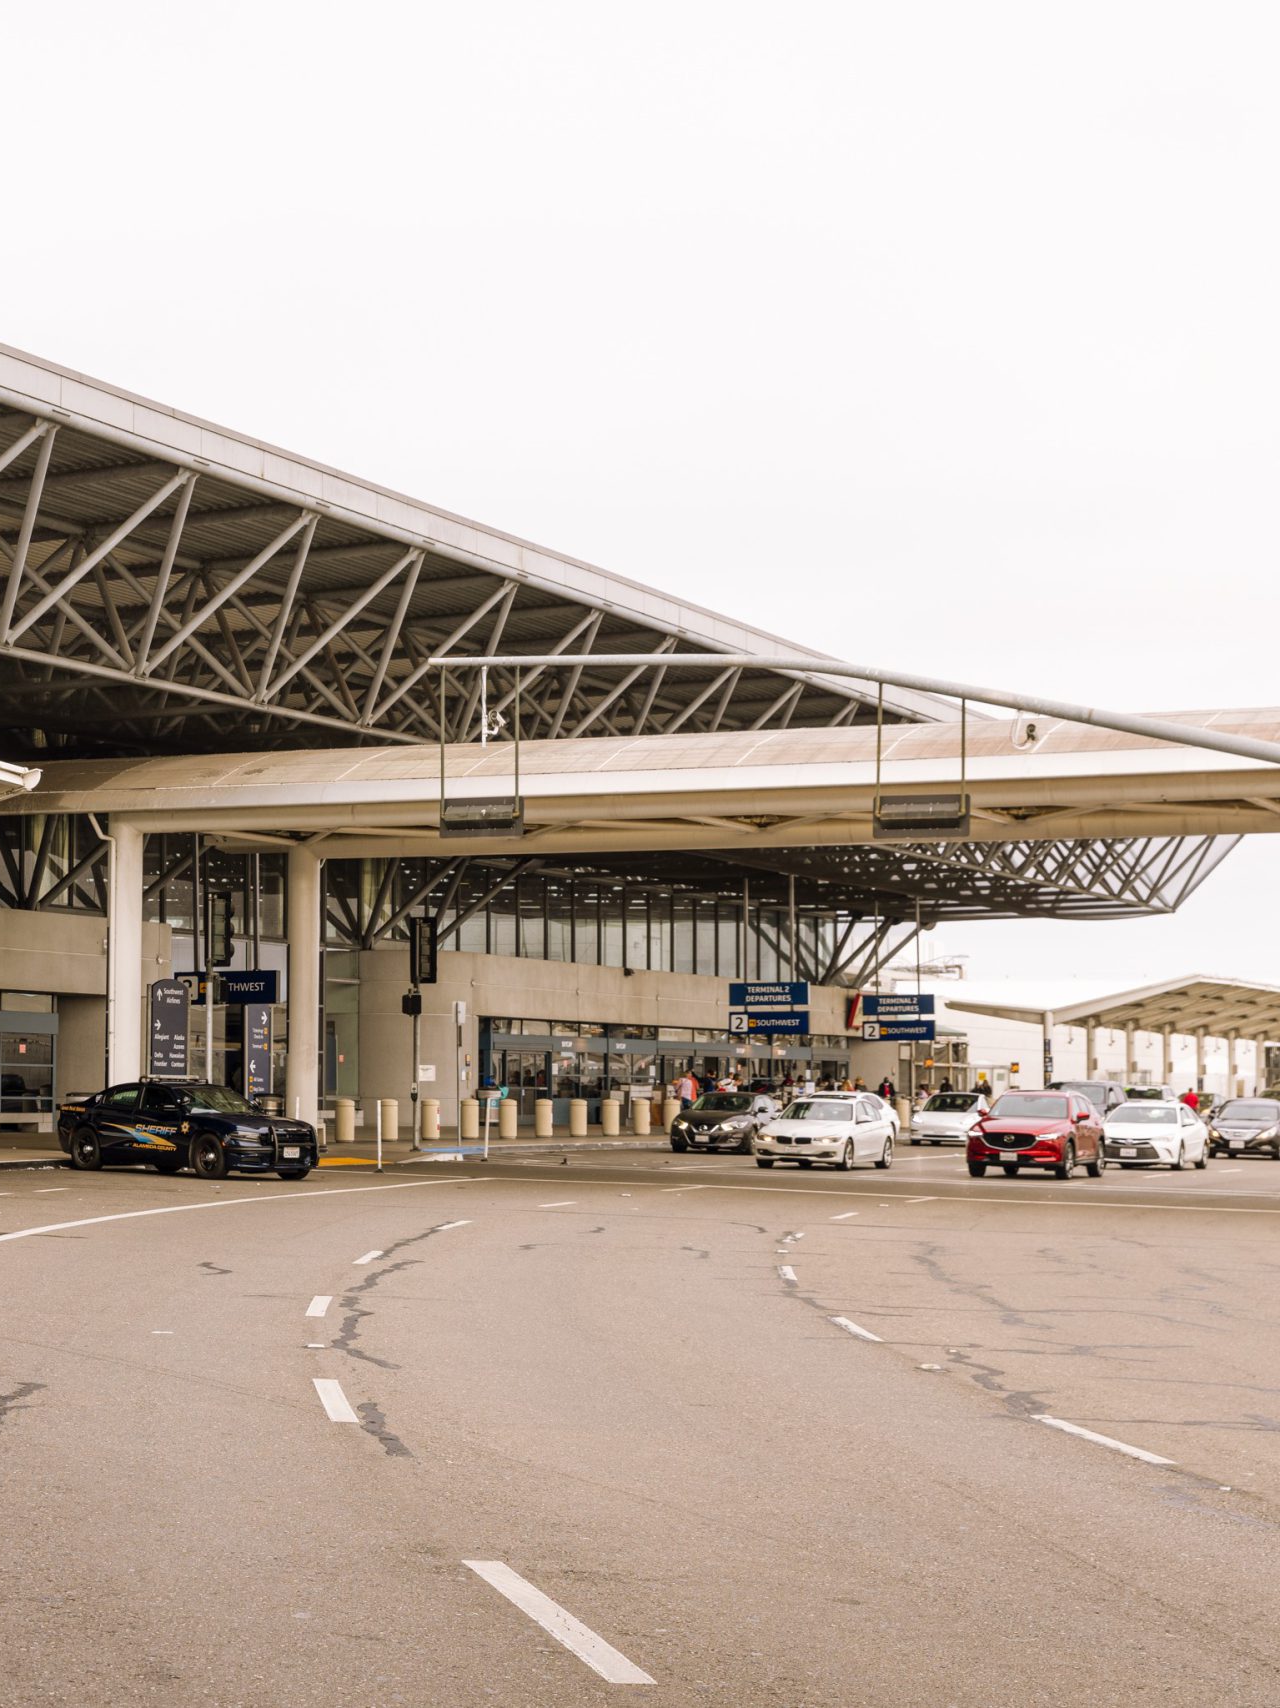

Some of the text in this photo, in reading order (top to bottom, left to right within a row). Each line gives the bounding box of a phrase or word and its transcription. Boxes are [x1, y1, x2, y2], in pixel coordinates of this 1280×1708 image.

[784, 985, 790, 993] 2
[745, 994, 792, 1002] DEPARTURES
[735, 1017, 800, 1030] 2 SOUTHWEST
[868, 1025, 876, 1037] 2
[135, 1123, 178, 1135] SHERIFF
